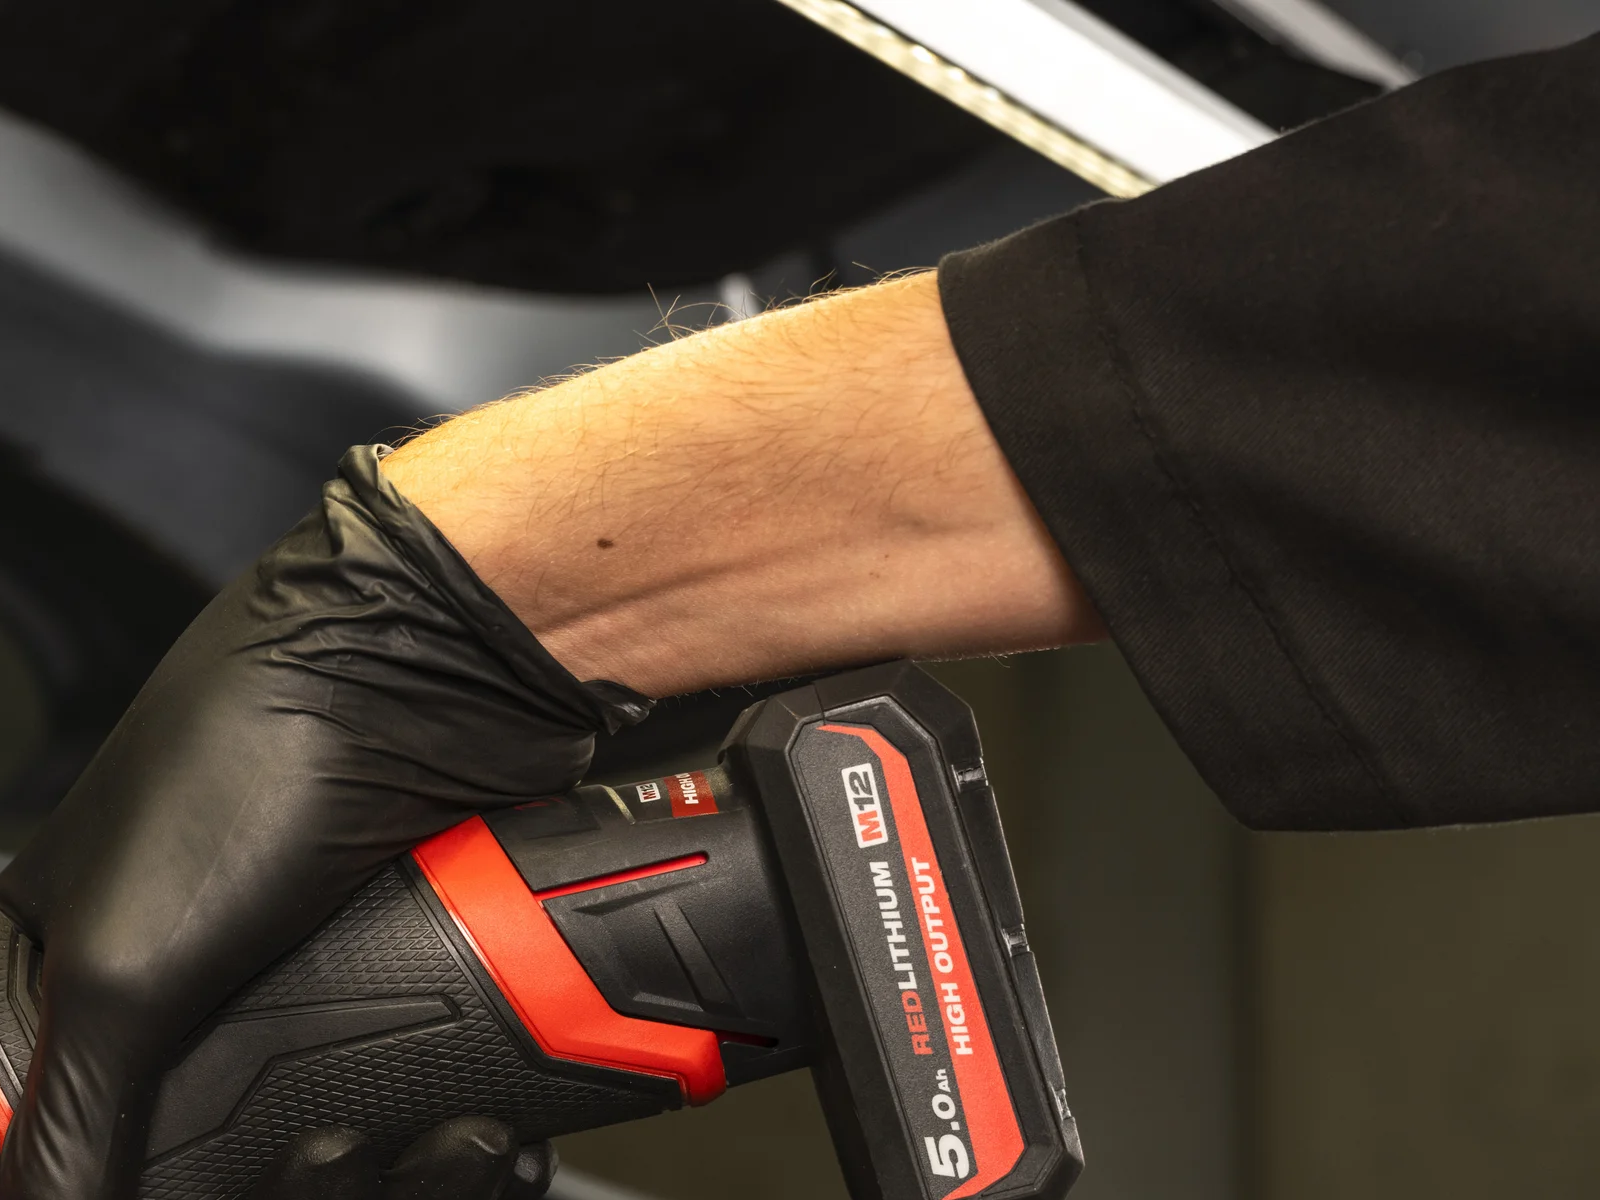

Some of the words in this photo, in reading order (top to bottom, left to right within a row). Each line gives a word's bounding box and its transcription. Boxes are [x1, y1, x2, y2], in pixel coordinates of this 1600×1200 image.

[640, 783, 657, 800] M12
[679, 778, 699, 804] HIGH
[849, 770, 884, 843] M12
[910, 856, 954, 974] OUTPUT
[868, 861, 932, 1056] REDLITHIUM
[940, 982, 974, 1056] HIGH
